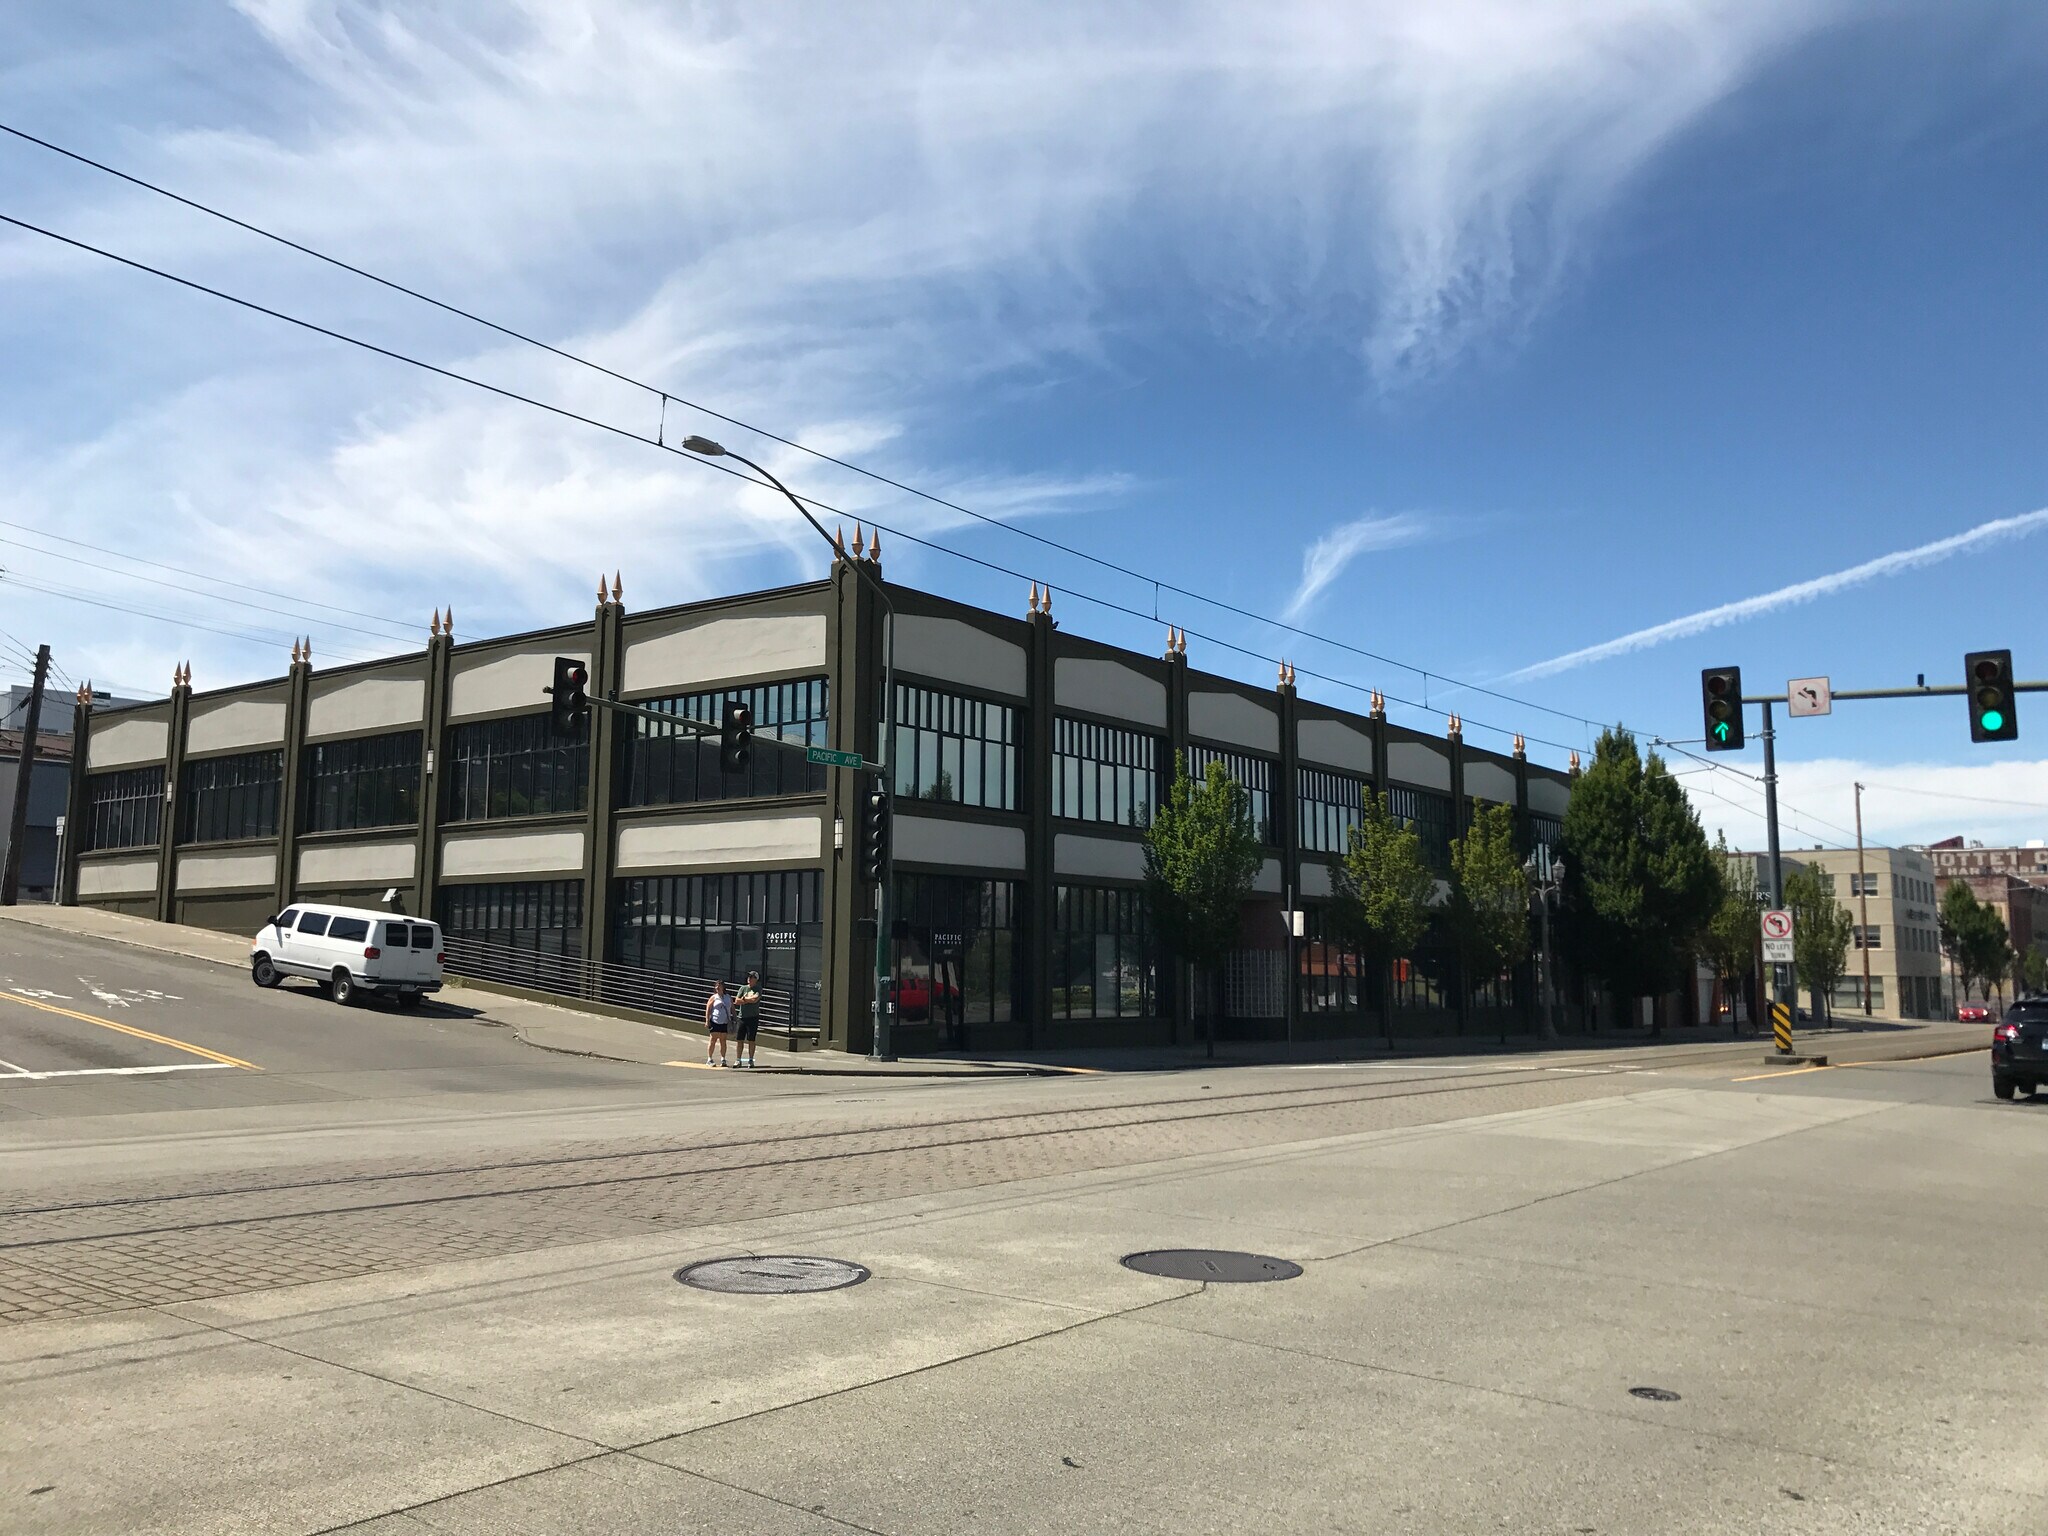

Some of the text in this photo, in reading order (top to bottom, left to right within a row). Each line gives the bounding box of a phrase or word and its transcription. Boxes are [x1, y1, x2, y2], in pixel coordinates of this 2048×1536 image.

[812, 750, 857, 765] PACIFIC AVE
[1947, 865, 2037, 876] HARWARE
[934, 933, 962, 941] PACIFIC
[1765, 942, 1775, 950] NO
